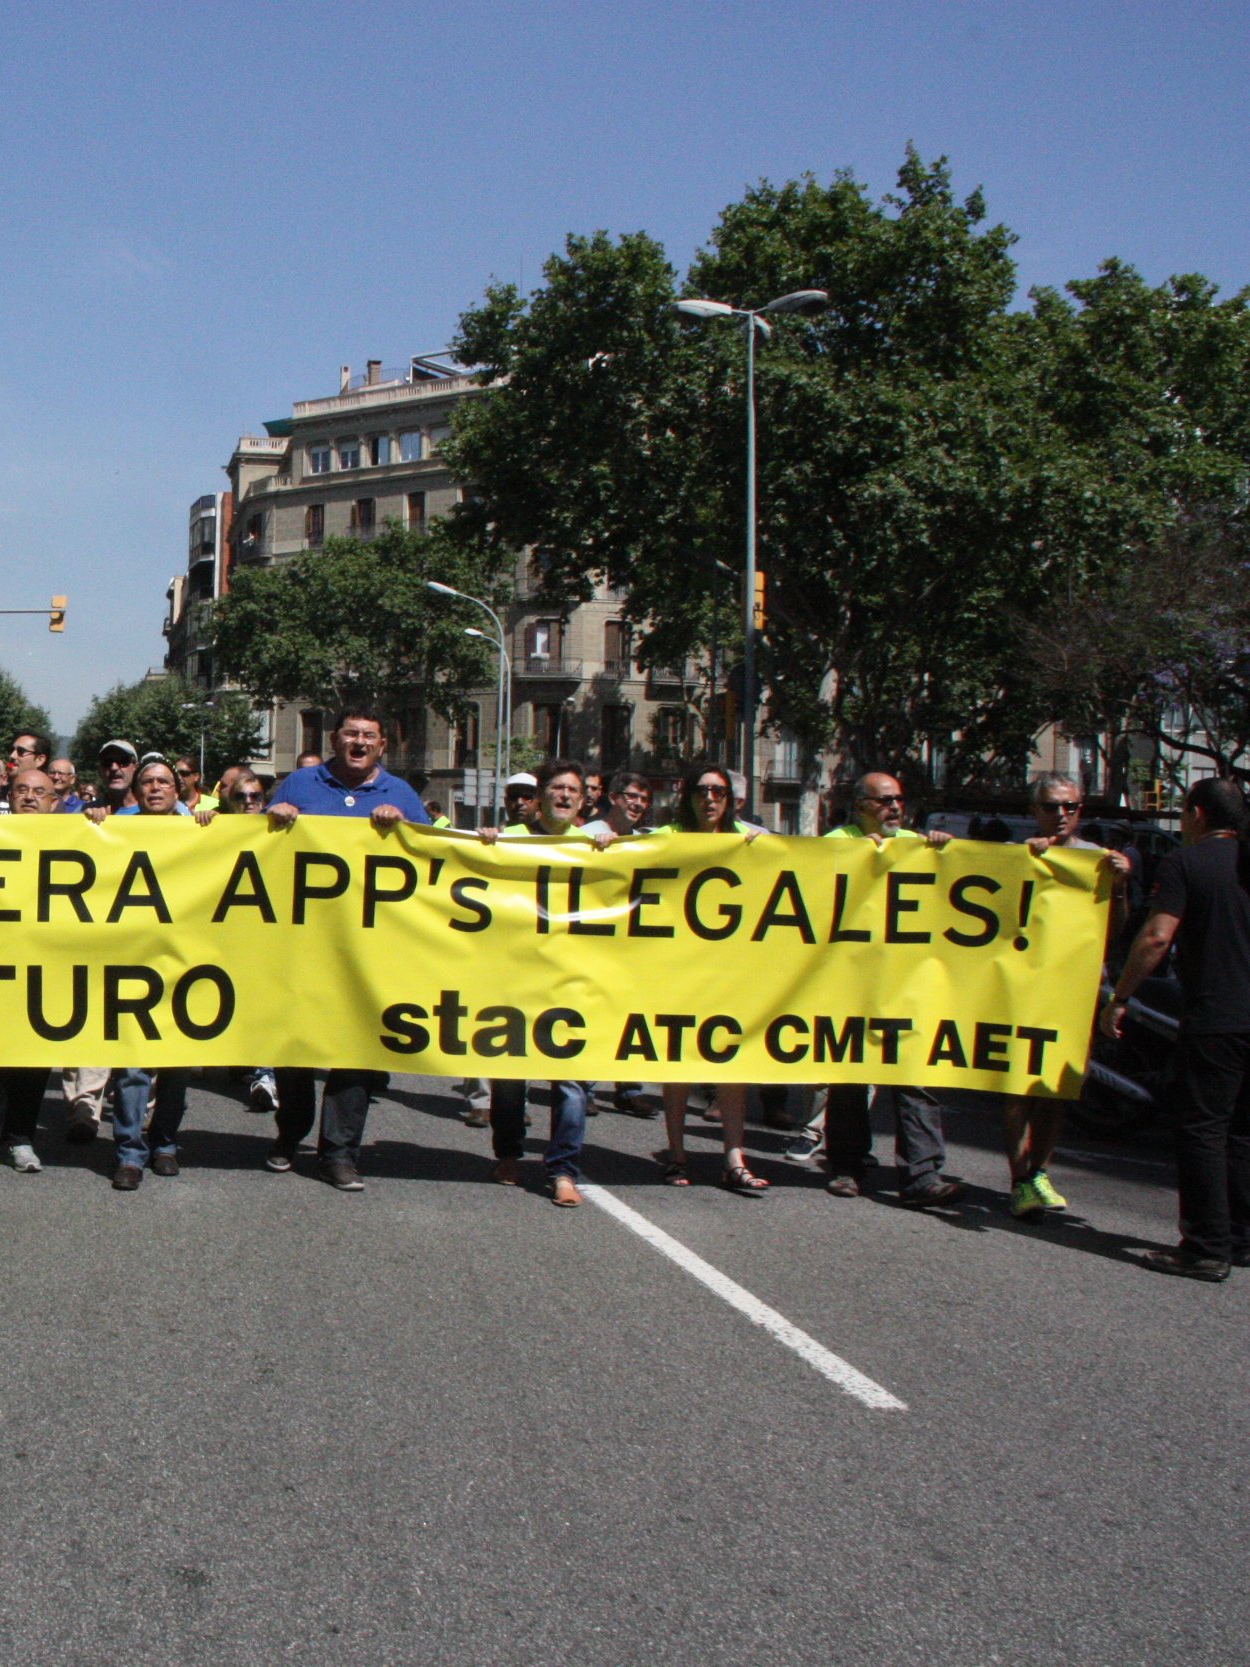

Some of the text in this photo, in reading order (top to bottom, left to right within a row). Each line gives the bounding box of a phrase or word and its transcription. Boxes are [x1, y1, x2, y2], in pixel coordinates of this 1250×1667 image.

[211, 850, 493, 933] APP's
[536, 865, 1035, 952] ILEGALES!
[379, 990, 1058, 1076] stac ATC CMT AET
